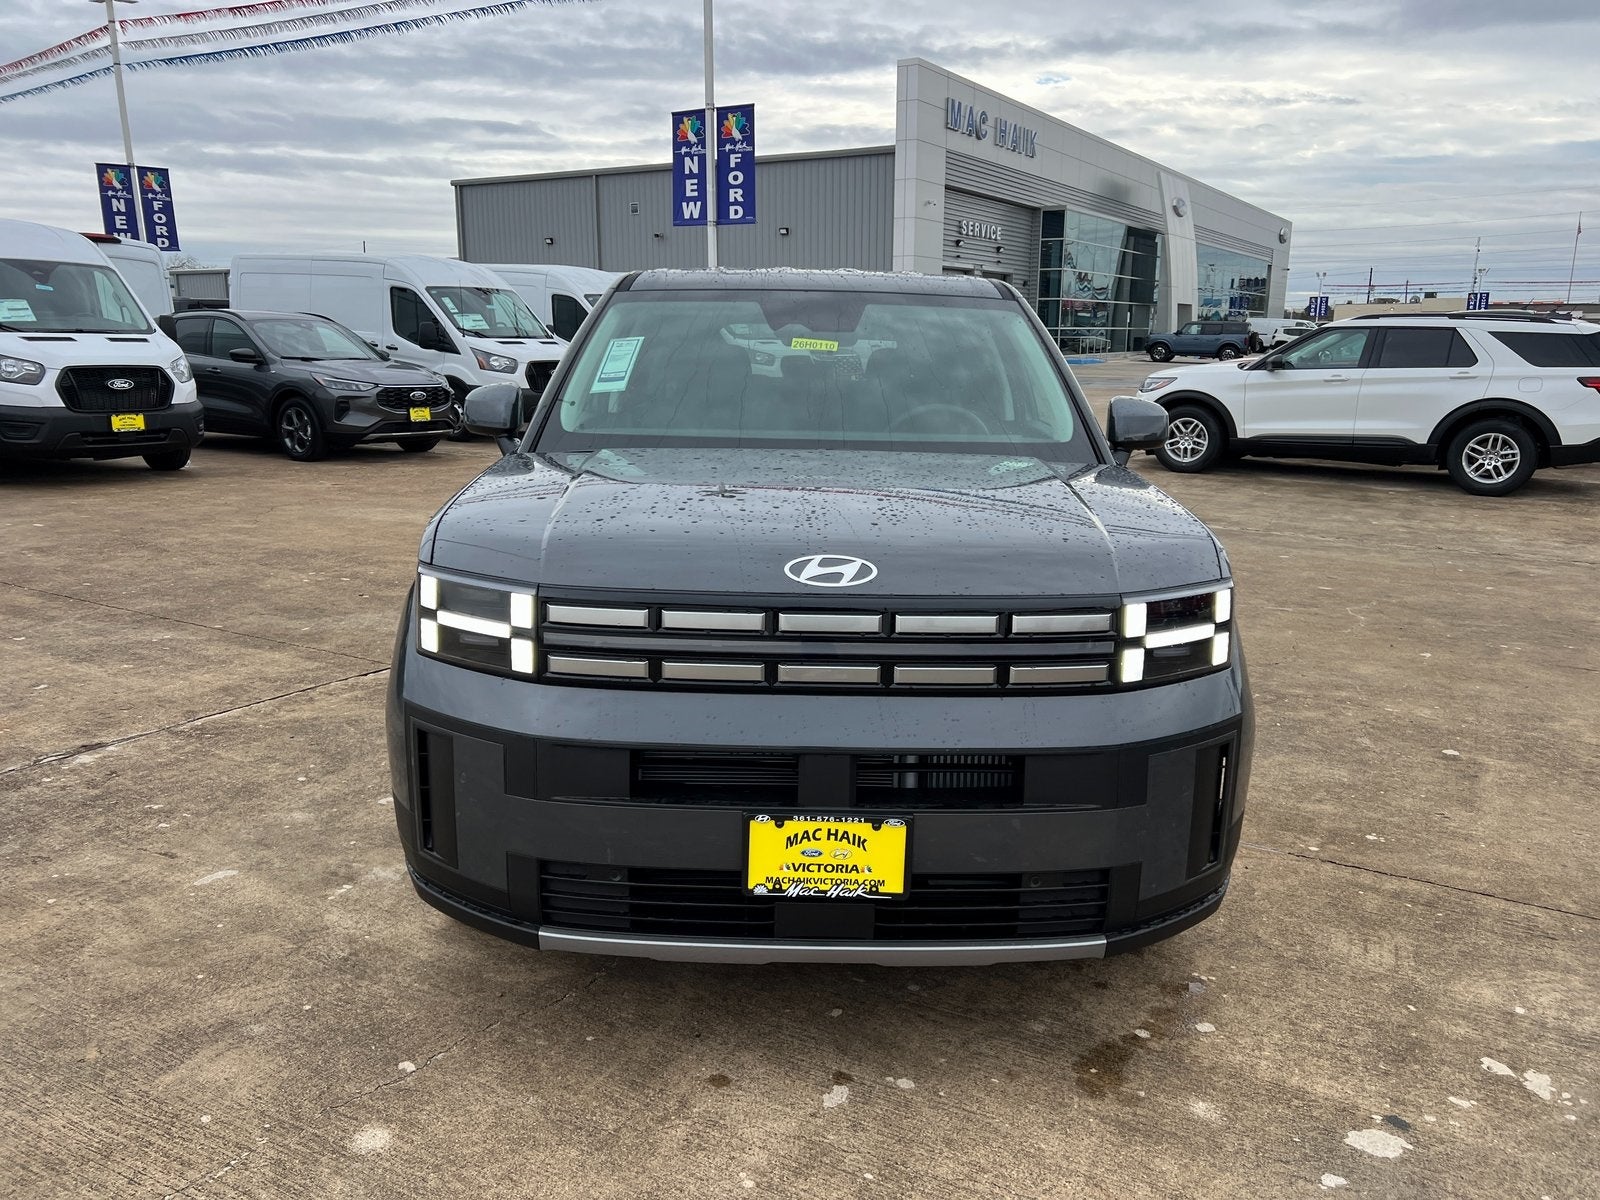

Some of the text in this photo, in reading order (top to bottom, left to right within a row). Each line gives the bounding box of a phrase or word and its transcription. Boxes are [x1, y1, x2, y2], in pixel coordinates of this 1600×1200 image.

[946, 97, 1037, 158] MAC HAIK
[682, 156, 701, 219] NEW
[728, 154, 744, 219] FORD
[153, 201, 170, 248] FORD
[962, 220, 1002, 240] SERVICE
[792, 340, 835, 350] 26H0110
[112, 380, 129, 388] Ford
[785, 828, 868, 852] MAC HAIK
[791, 862, 860, 874] VICTORIA
[783, 882, 873, 898] Mac Haik
